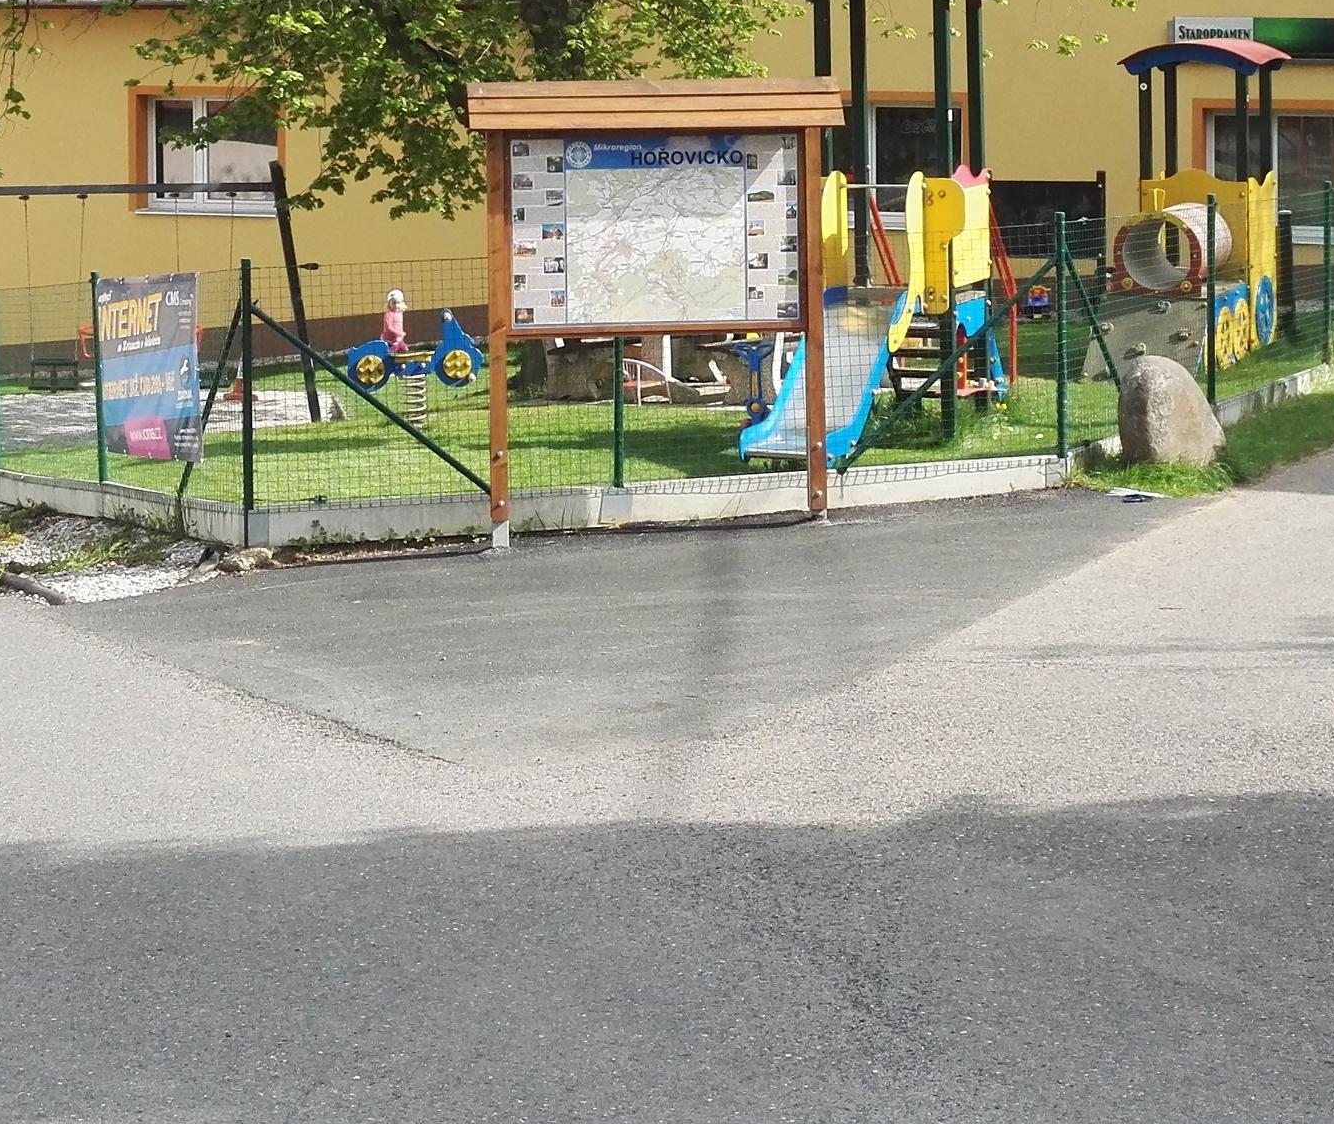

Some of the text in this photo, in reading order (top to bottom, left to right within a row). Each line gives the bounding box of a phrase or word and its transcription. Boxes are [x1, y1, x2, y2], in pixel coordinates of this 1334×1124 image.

[1178, 25, 1251, 41] STAROPRAMEN
[593, 143, 642, 153] Mikroregion
[631, 147, 744, 166] HOŘOVICKO
[98, 292, 163, 343] INTERNET
